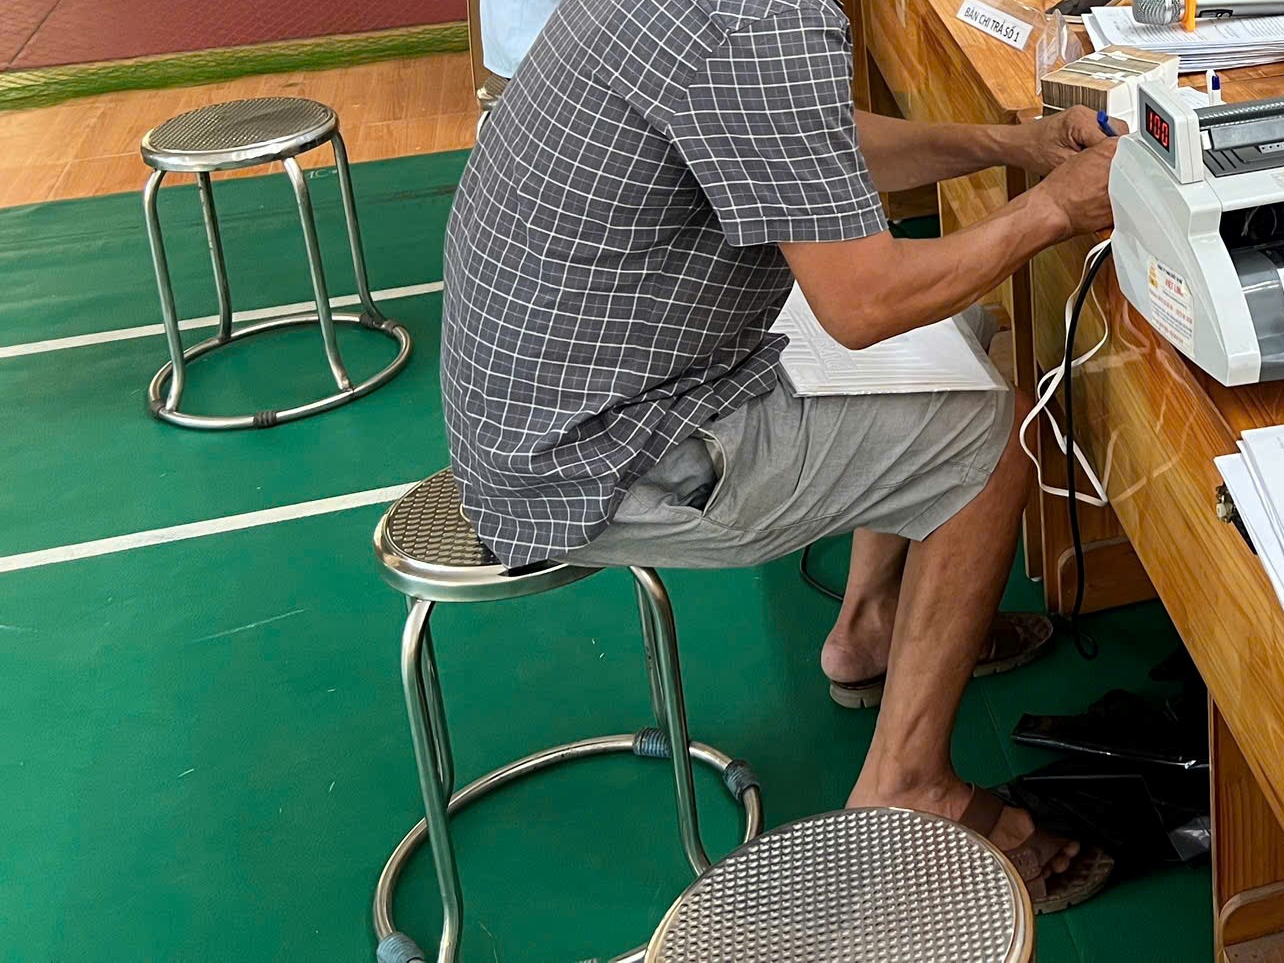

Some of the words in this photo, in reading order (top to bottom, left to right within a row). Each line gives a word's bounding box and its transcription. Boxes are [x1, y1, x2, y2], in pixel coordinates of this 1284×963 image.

[964, 6, 978, 22] BÀN
[978, 14, 991, 28] CHI
[1013, 31, 1020, 43] 1
[1149, 110, 1169, 147] 100
